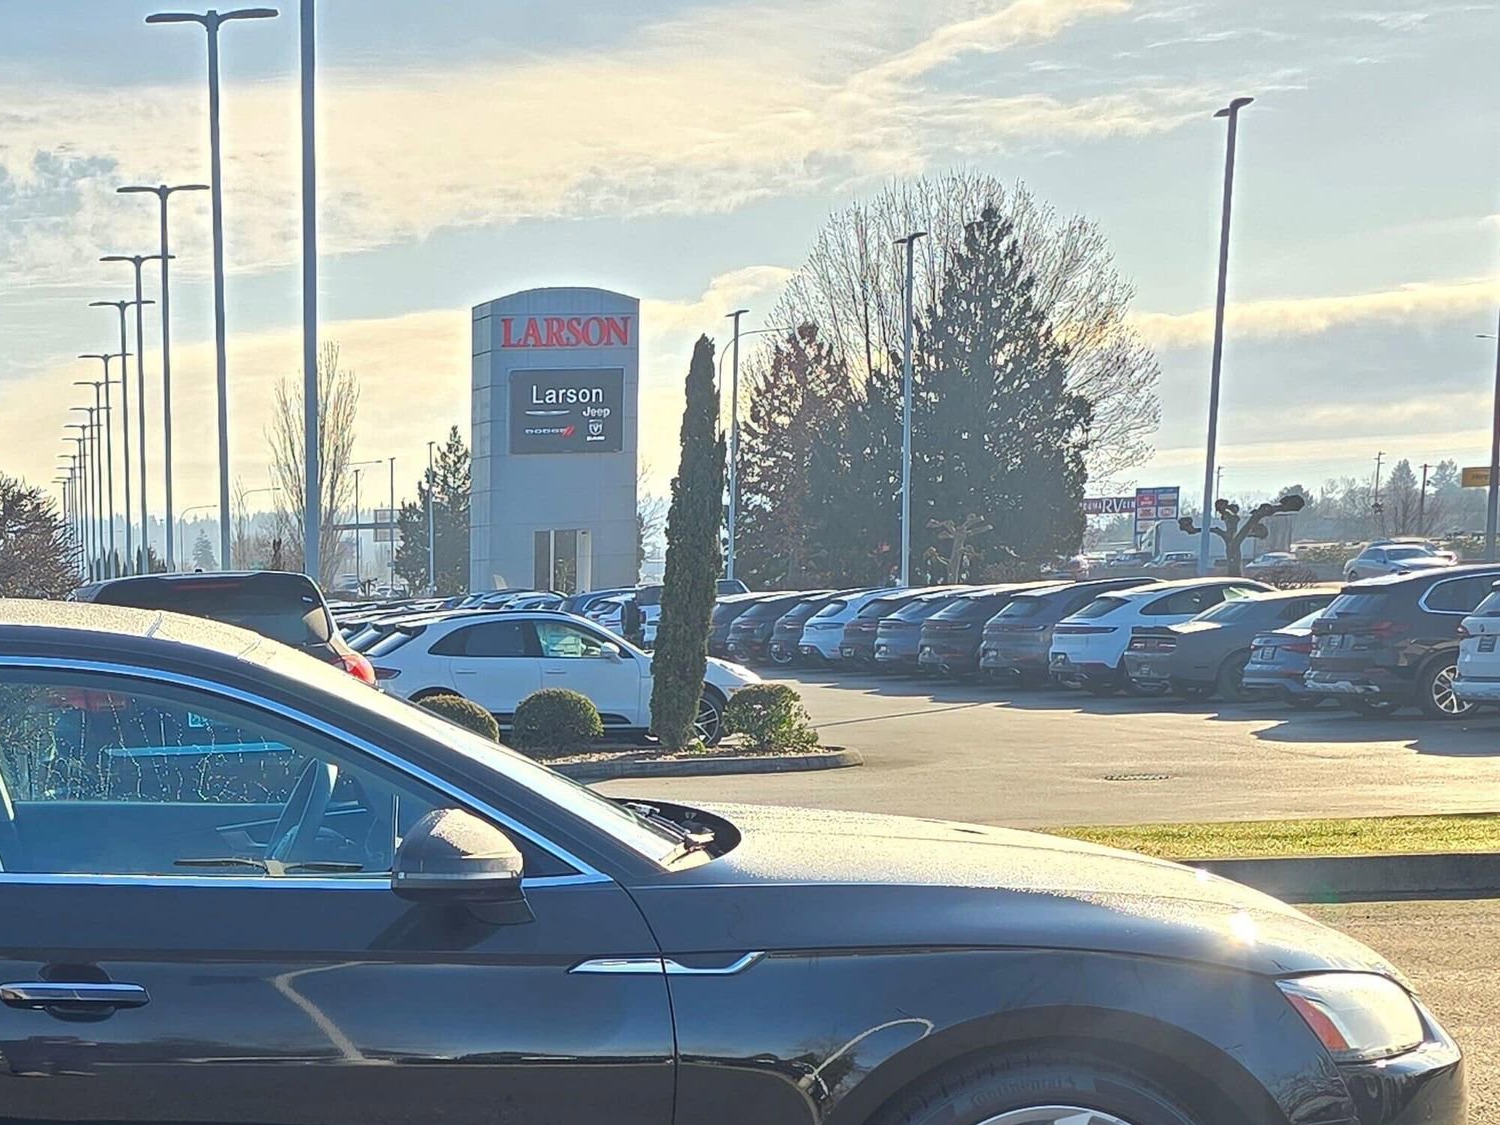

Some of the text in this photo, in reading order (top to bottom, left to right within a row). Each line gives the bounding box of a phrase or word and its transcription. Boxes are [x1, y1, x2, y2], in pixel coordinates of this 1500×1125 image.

[501, 316, 631, 348] LARSON
[532, 385, 603, 404] Larson
[582, 406, 610, 418] Jeep
[1101, 498, 1124, 512] RV
